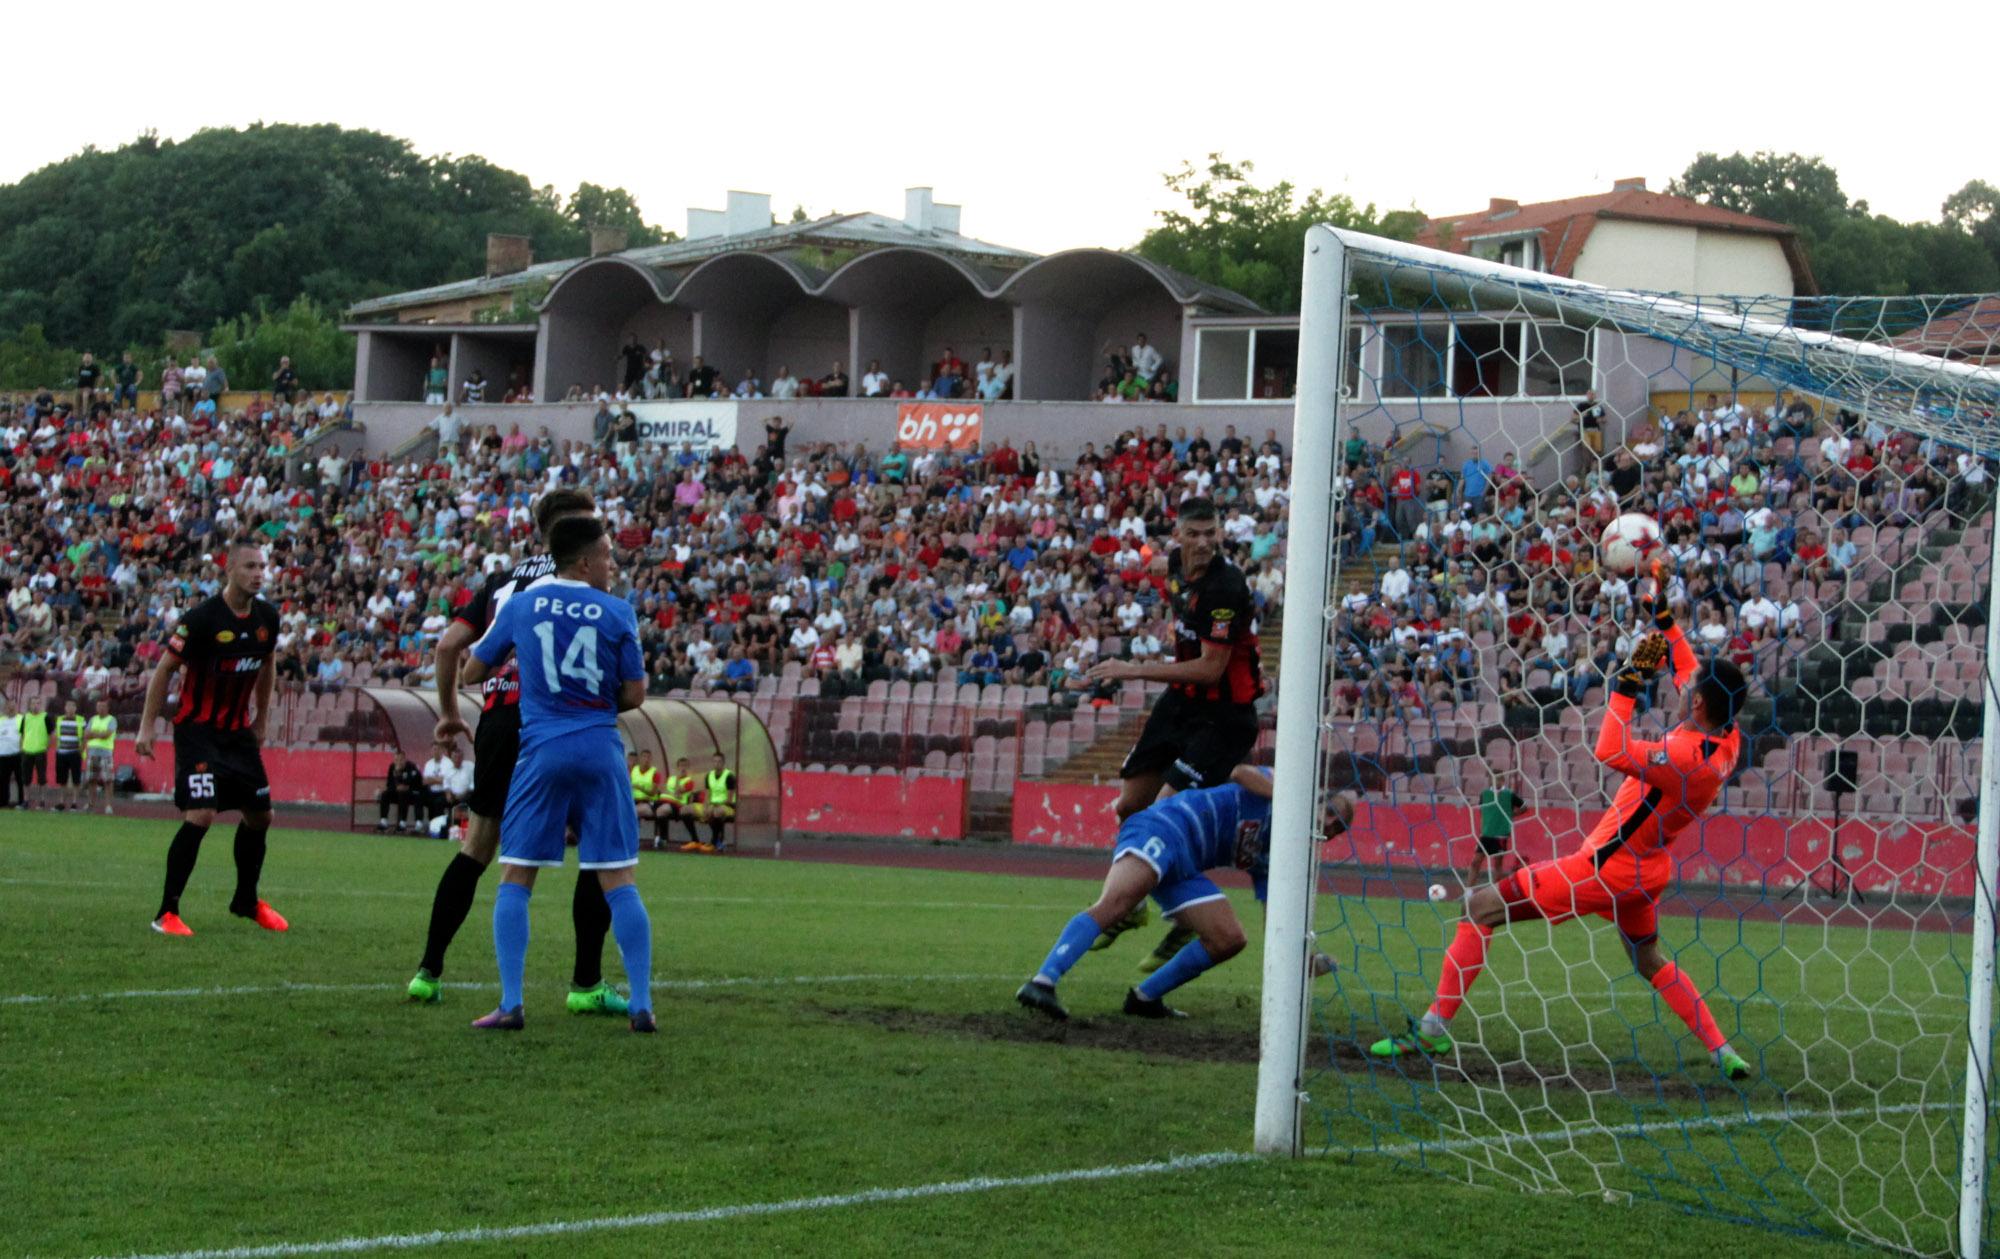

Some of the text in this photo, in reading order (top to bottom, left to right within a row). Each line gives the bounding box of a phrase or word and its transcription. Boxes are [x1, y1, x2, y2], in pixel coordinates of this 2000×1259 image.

[639, 418, 721, 438] DMIRAL
[899, 413, 938, 441] bh
[534, 597, 603, 620] PECO
[533, 621, 605, 695] 14
[188, 773, 215, 798] 55
[1142, 836, 1166, 859] 6
